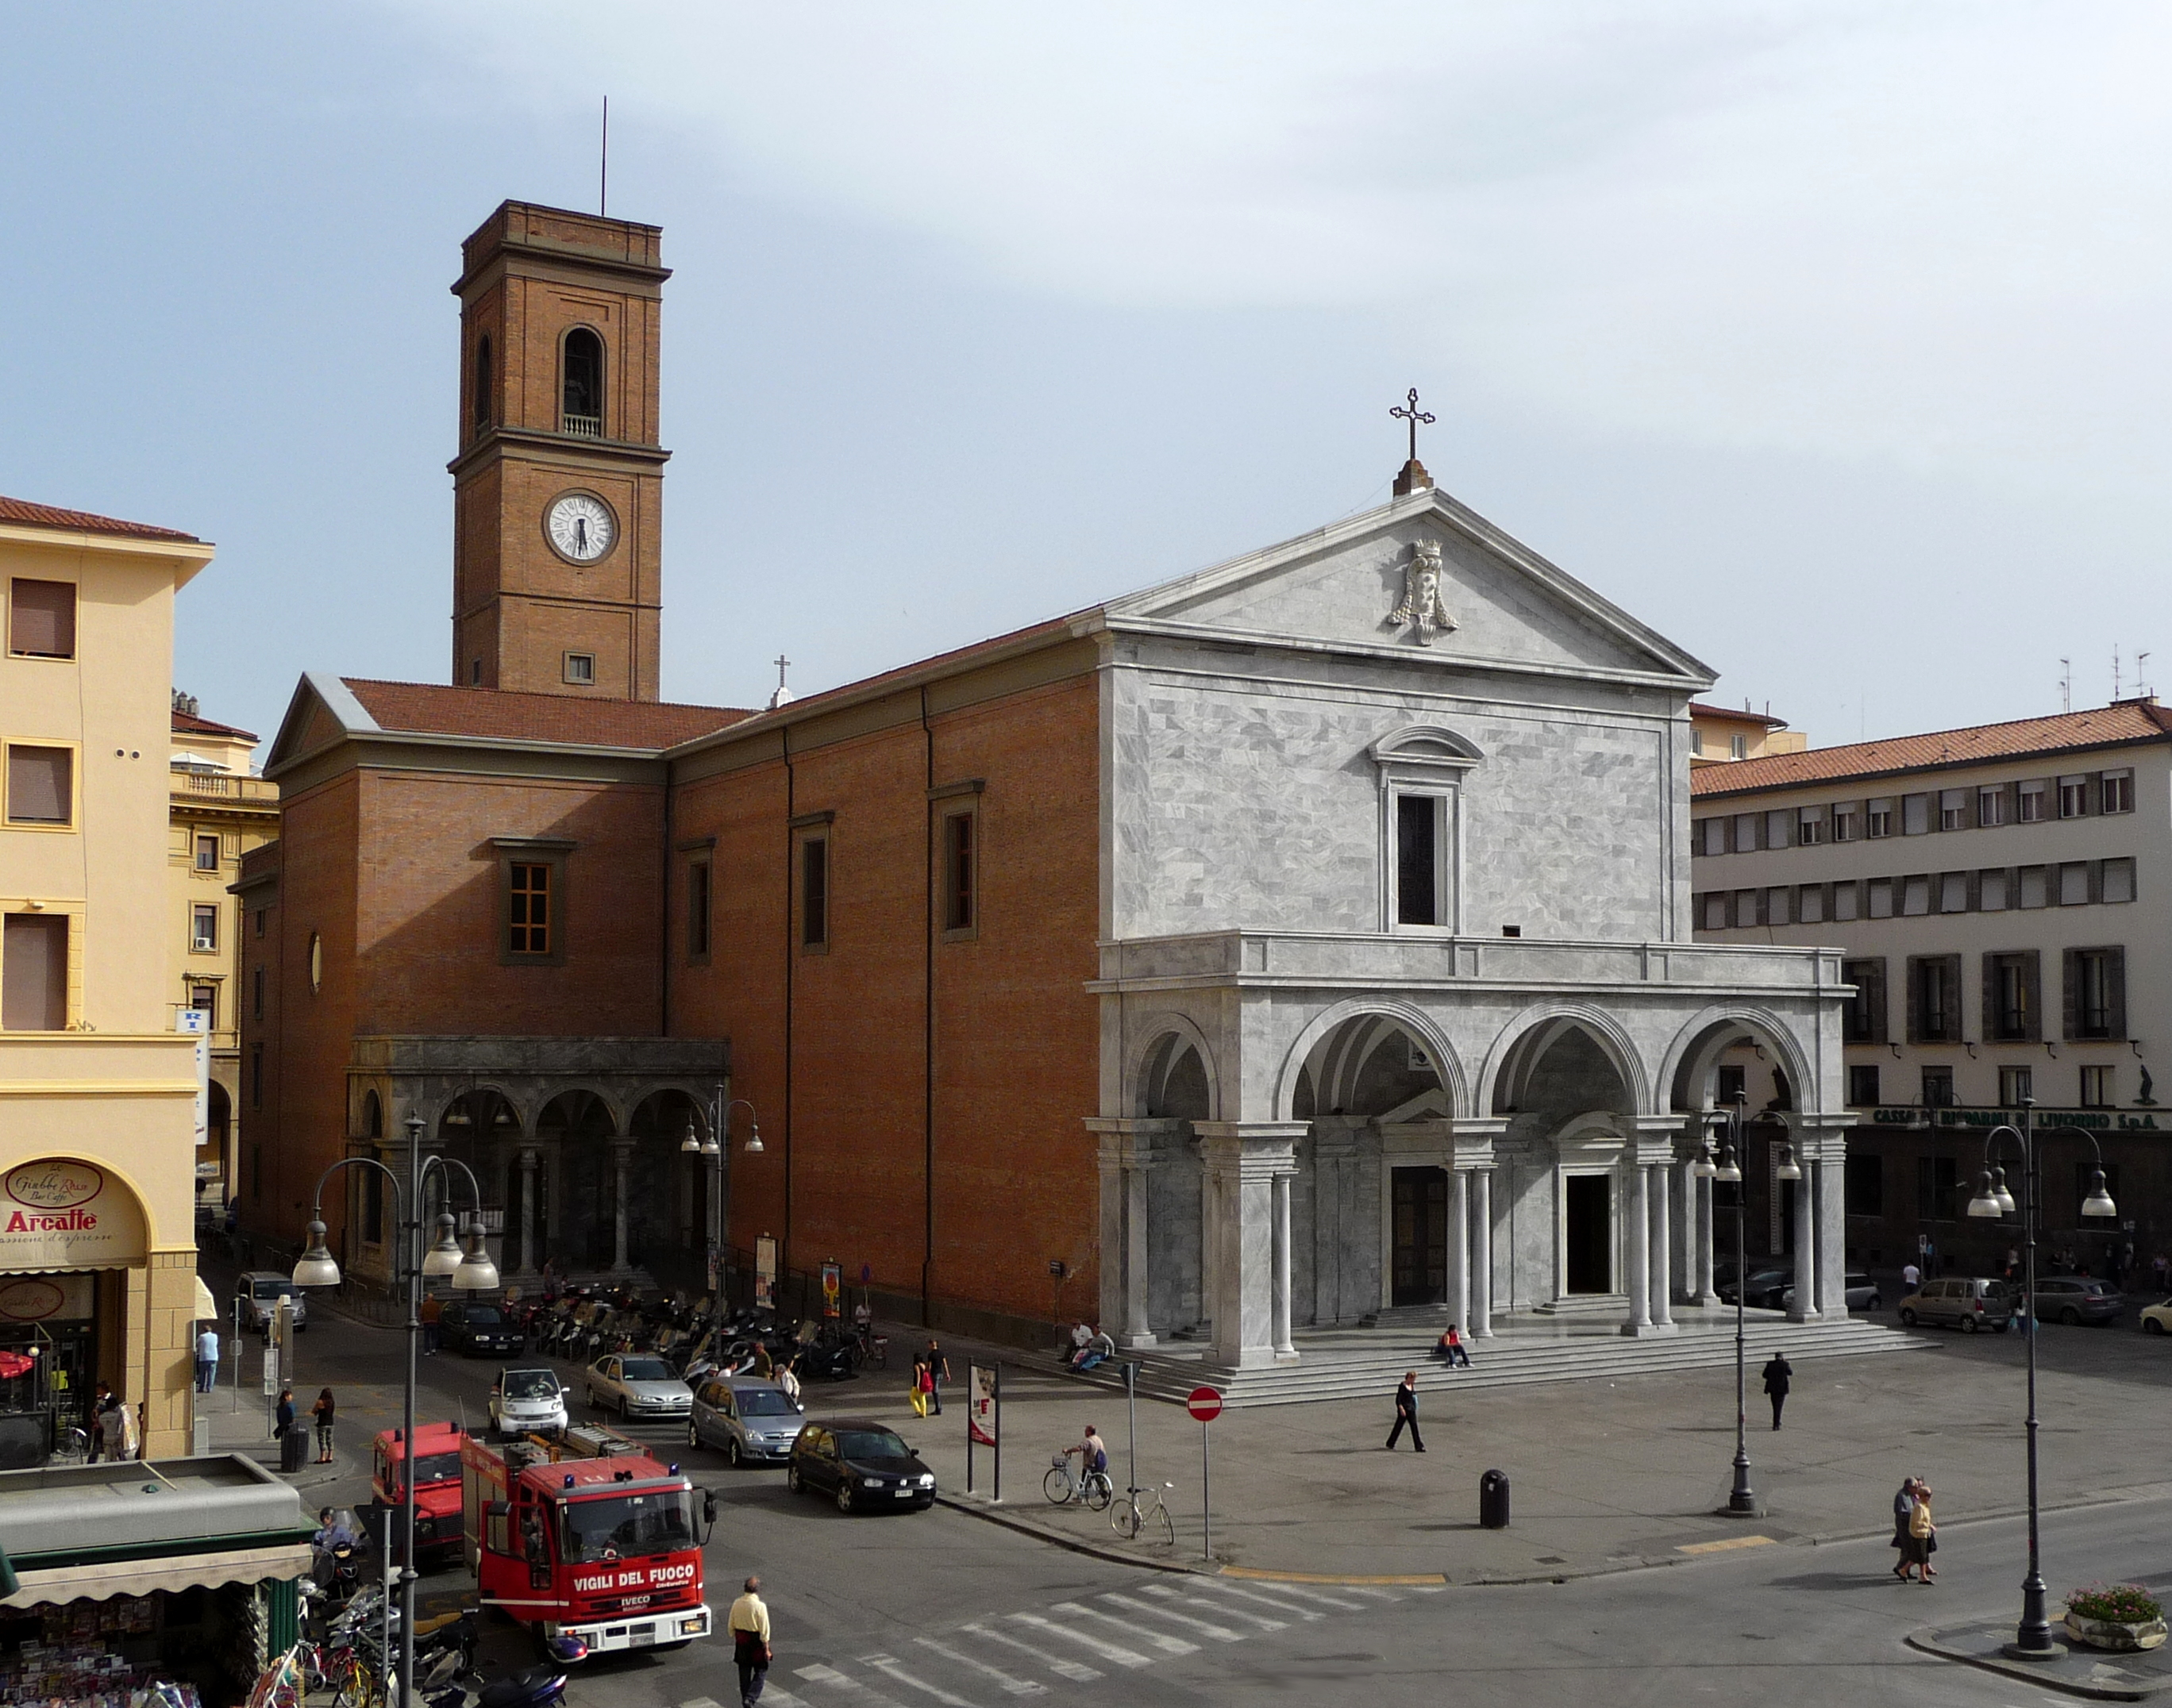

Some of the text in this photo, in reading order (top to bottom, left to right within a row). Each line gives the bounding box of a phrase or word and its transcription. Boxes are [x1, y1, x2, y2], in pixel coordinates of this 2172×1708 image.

[1942, 1110, 2008, 1126] RIPARMI
[2039, 1113, 2110, 1129] LIVORNO
[30, 1191, 46, 1200] Bar
[5, 1209, 97, 1233] Arcaffè
[574, 1564, 694, 1591] VIGILI DEL FUOCO
[621, 1595, 650, 1606] IVECO
